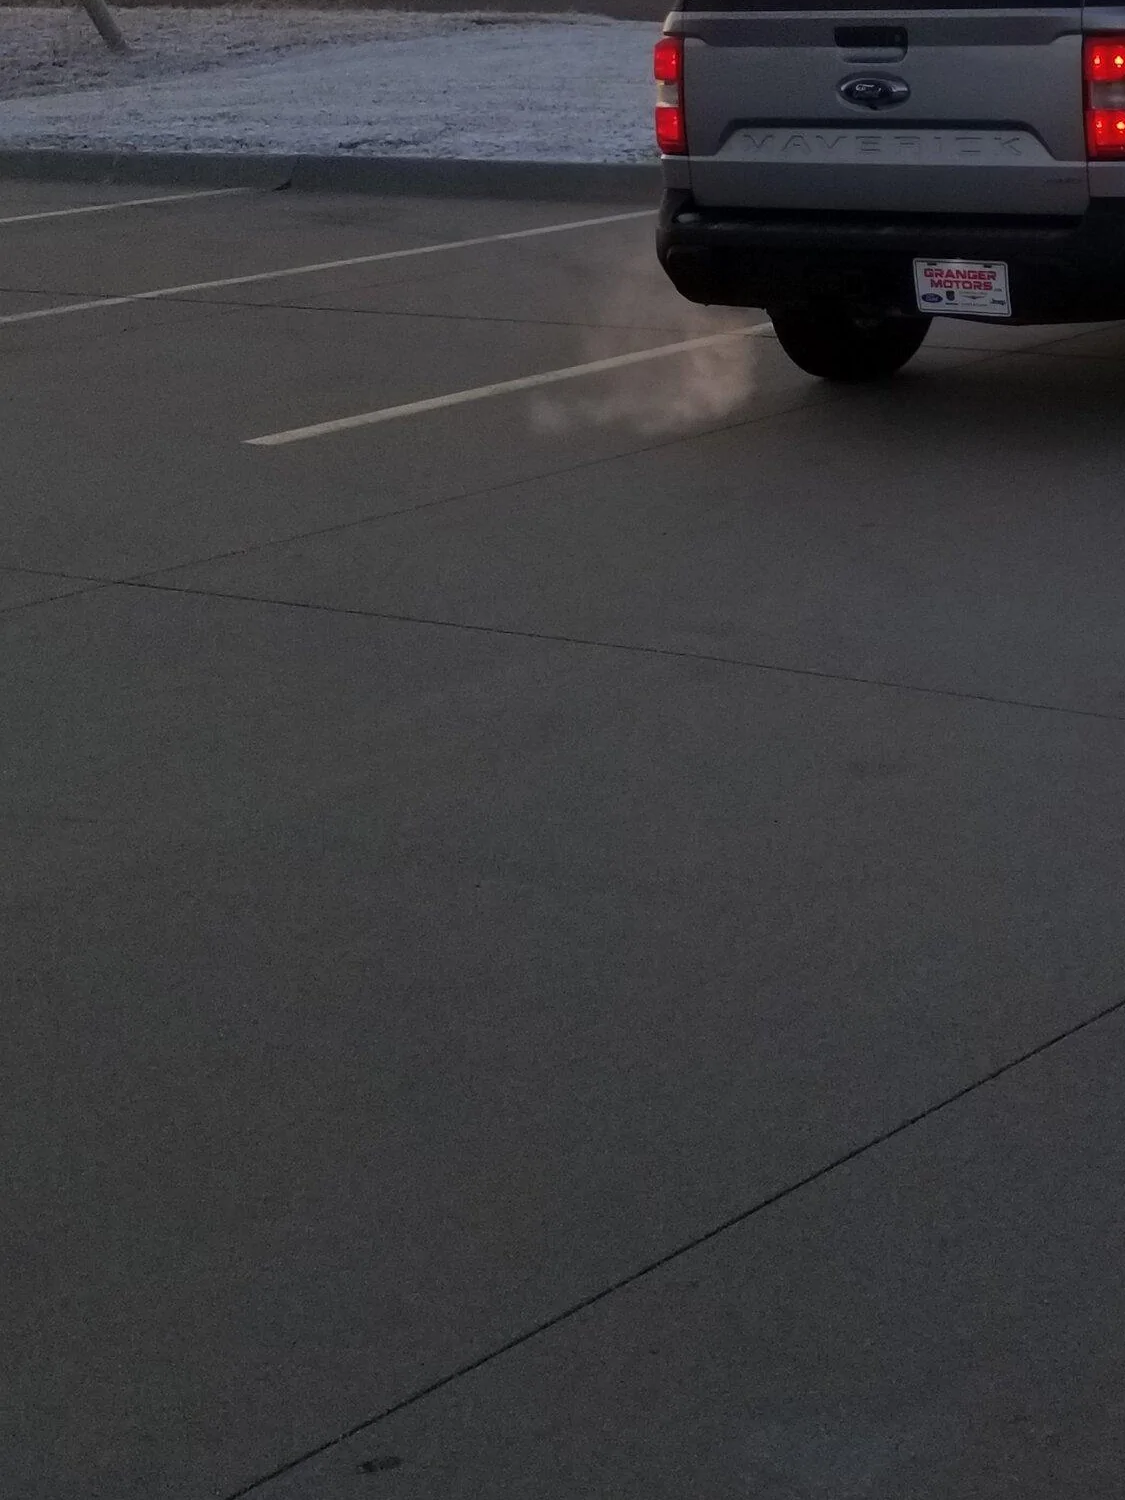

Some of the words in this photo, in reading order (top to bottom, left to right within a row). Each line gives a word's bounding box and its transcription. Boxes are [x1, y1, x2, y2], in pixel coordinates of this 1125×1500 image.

[743, 134, 1023, 156] MAVERICK
[924, 268, 997, 280] GRANGER
[930, 279, 993, 291] MOTORS
